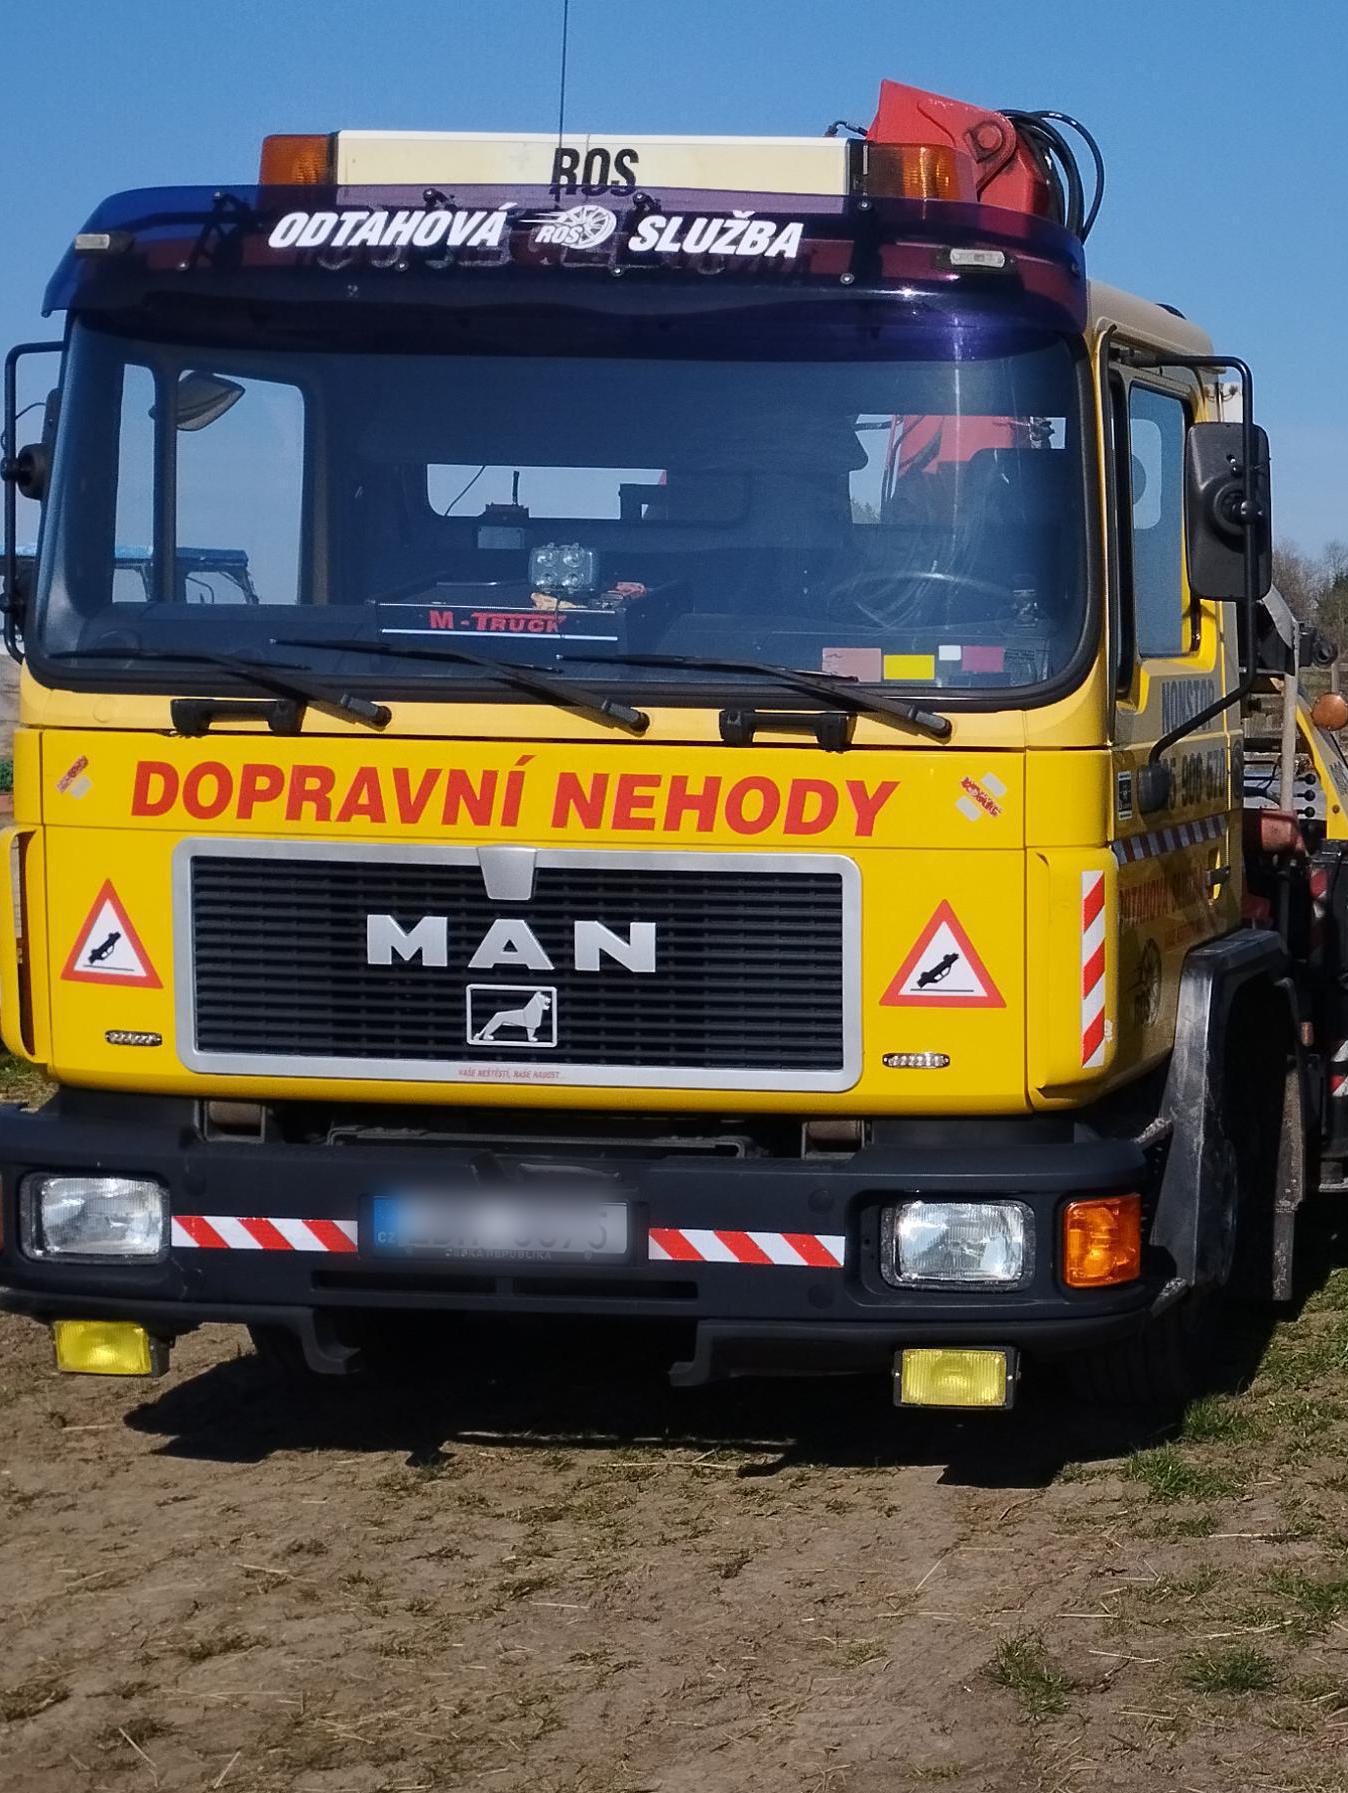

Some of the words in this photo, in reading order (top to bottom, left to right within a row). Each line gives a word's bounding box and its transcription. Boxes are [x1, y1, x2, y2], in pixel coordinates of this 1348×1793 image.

[549, 147, 639, 196] ROS
[268, 203, 518, 248] ODTAHOVÁ
[534, 224, 586, 244] ROS
[627, 210, 804, 258] SLUŽBA
[131, 755, 537, 828] DOPRAVNÍ
[551, 772, 901, 837] NEHODY
[367, 914, 656, 973] MAN
